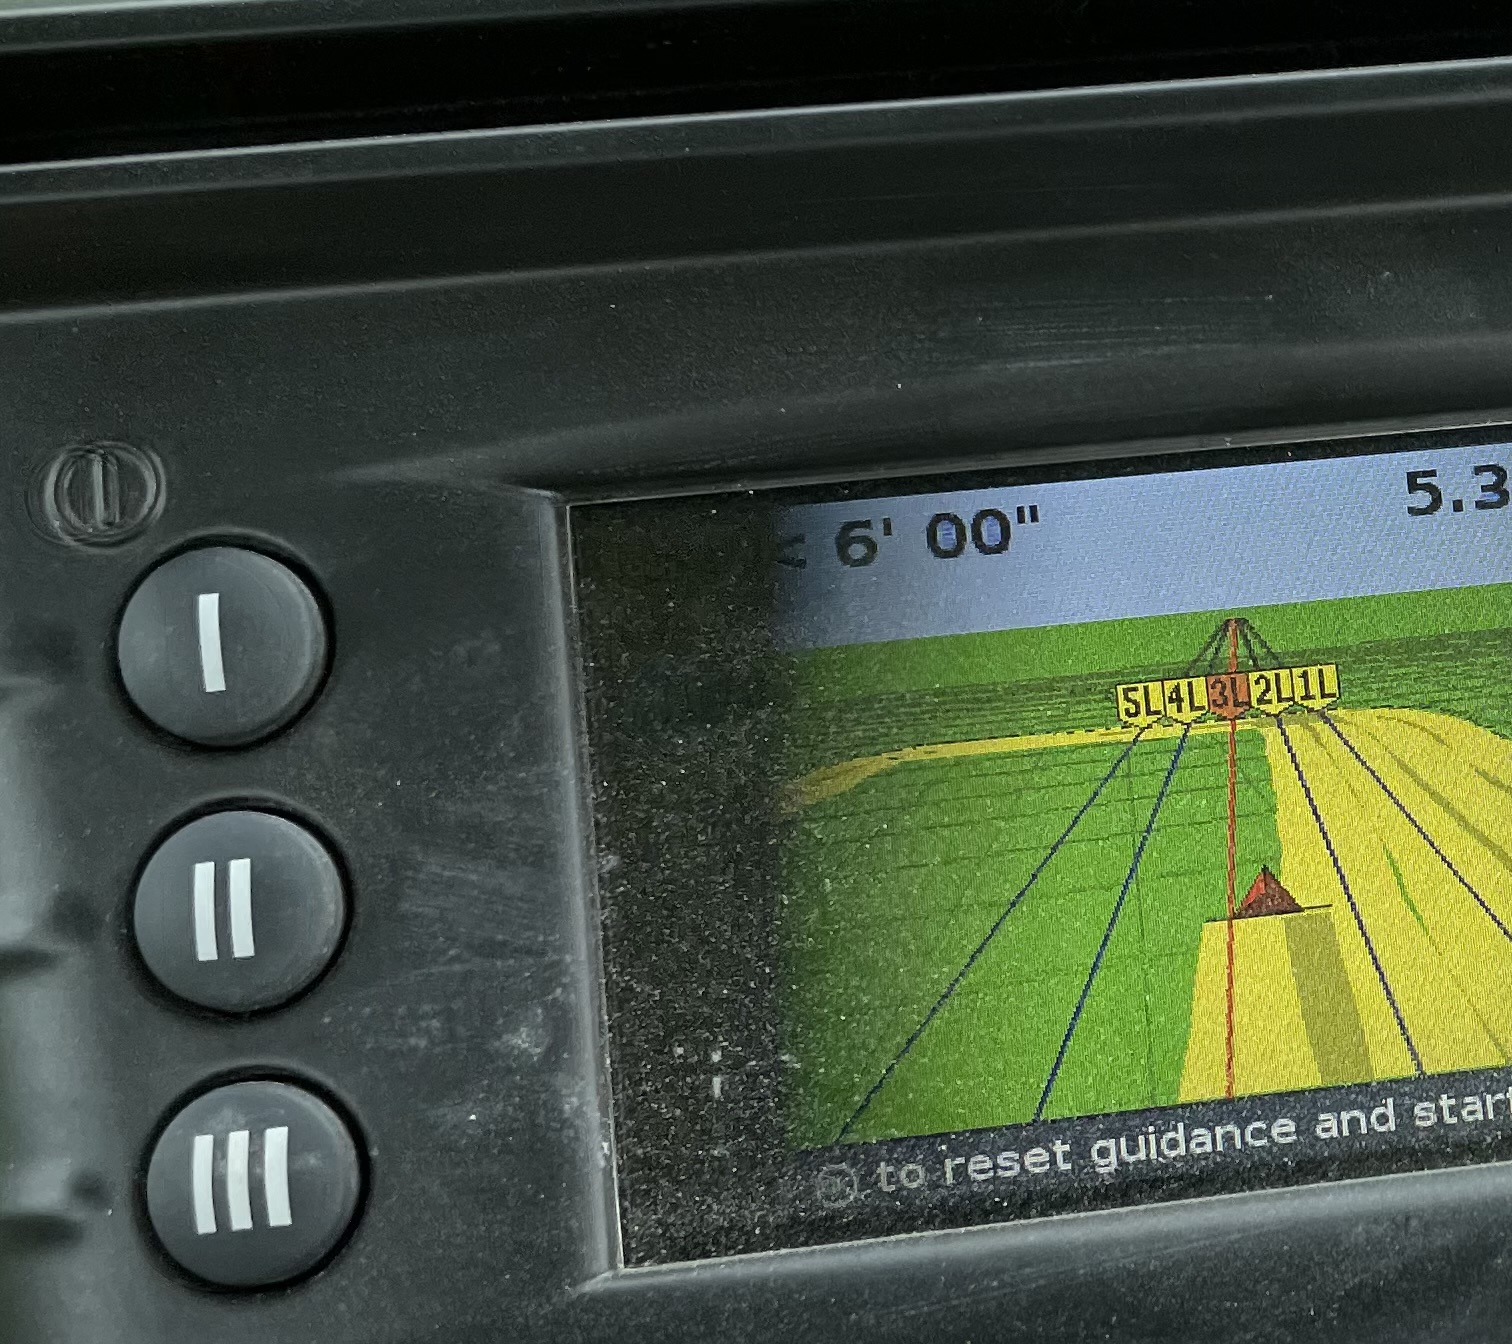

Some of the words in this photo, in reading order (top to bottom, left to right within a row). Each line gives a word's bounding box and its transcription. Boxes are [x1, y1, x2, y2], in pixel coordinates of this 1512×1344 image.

[1406, 462, 1510, 517] 5.3
[1122, 684, 1163, 719] 5L
[1167, 679, 1207, 713] 4L
[1210, 675, 1250, 709] 3L
[1254, 670, 1294, 706] 2L
[1297, 667, 1337, 700] 1L
[876, 1159, 926, 1193] to
[943, 1137, 1073, 1186] reset
[1090, 1116, 1298, 1174] guidance
[1314, 1096, 1397, 1140] and
